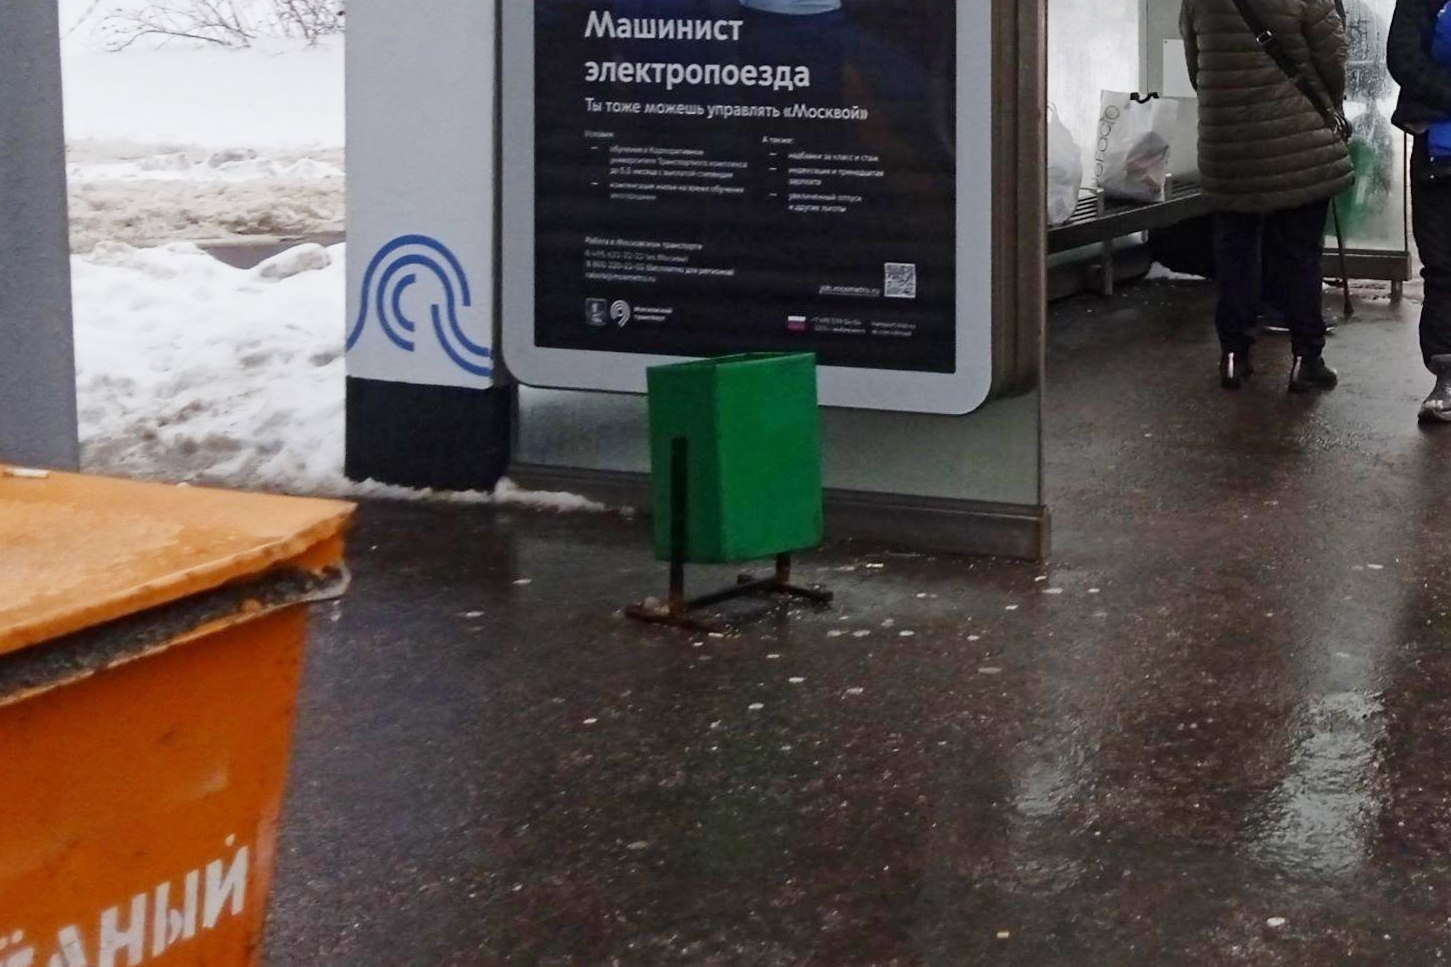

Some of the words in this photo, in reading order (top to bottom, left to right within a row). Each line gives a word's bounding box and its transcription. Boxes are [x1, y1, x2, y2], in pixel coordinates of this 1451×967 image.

[584, 10, 744, 41] Машинист
[584, 60, 811, 91] электропоезда
[585, 97, 602, 112] Ты
[605, 101, 641, 114] тоже
[644, 104, 705, 115] можешь
[707, 106, 780, 119] управлять
[783, 103, 869, 121] «Москвой»
